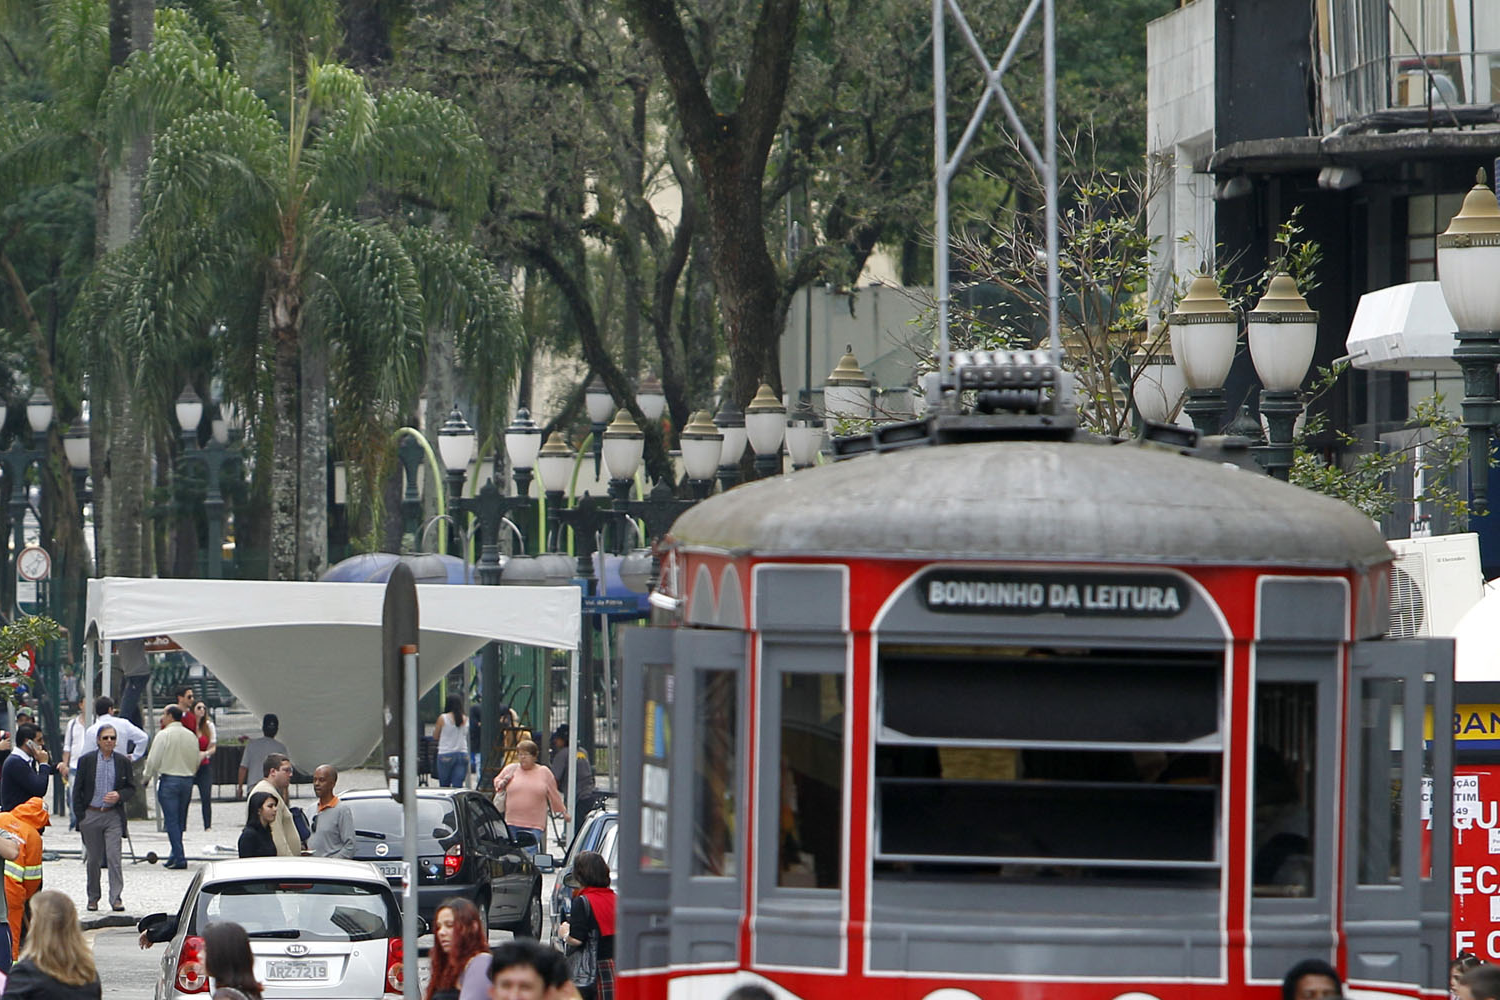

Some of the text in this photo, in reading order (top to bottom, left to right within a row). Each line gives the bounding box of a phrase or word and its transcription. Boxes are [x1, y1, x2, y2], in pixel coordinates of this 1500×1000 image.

[928, 580, 1180, 610] BONDINHO DA LEITURA
[290, 945, 305, 953] KIA
